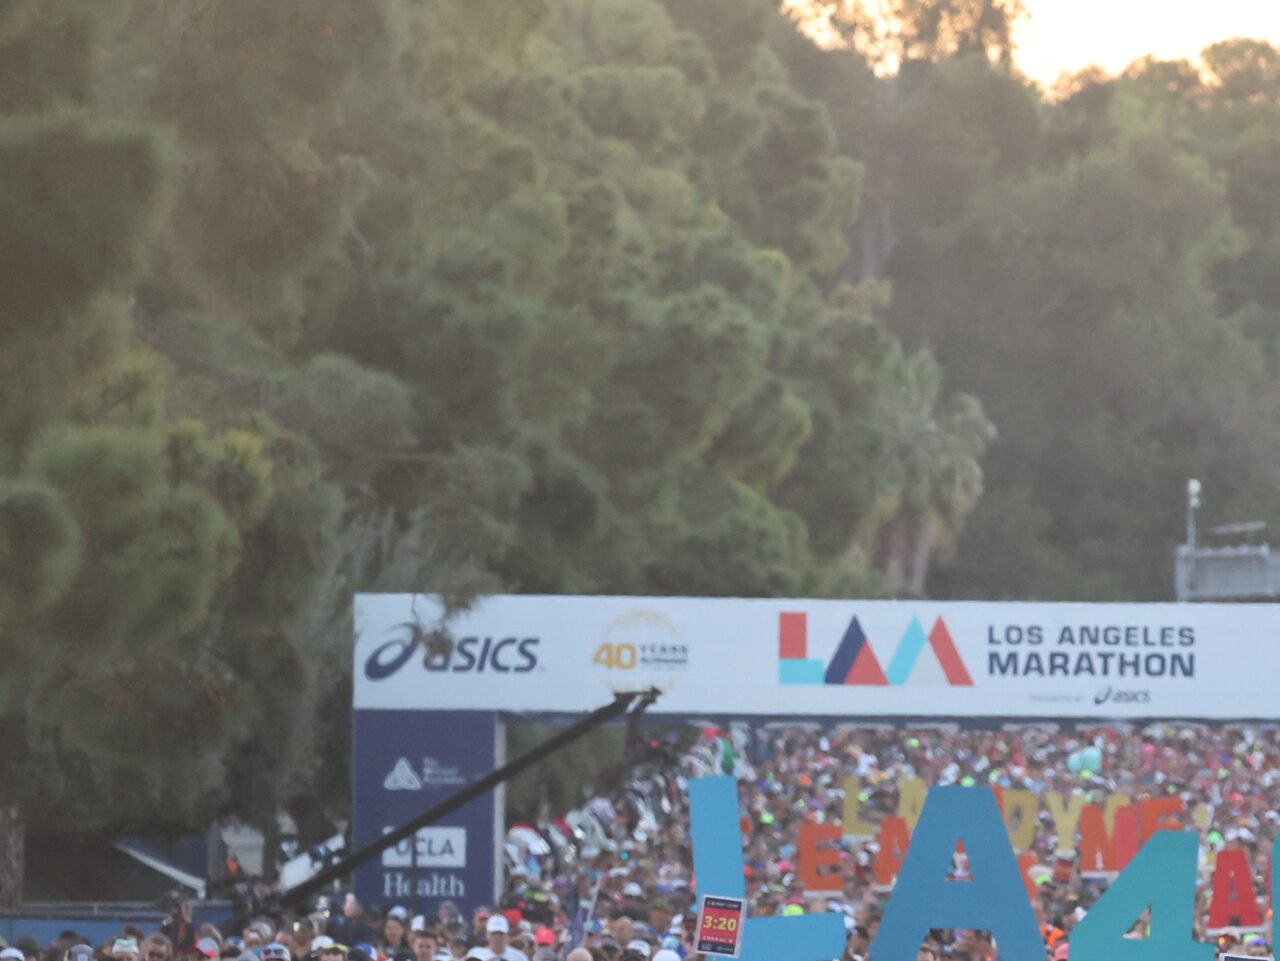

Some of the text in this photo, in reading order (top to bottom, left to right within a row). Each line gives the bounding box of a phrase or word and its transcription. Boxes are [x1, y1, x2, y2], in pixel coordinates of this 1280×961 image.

[988, 625, 1196, 647] LOS ANGELES
[593, 643, 637, 670] 40
[988, 652, 1196, 678] MARATHON
[703, 915, 738, 932] 3:20
